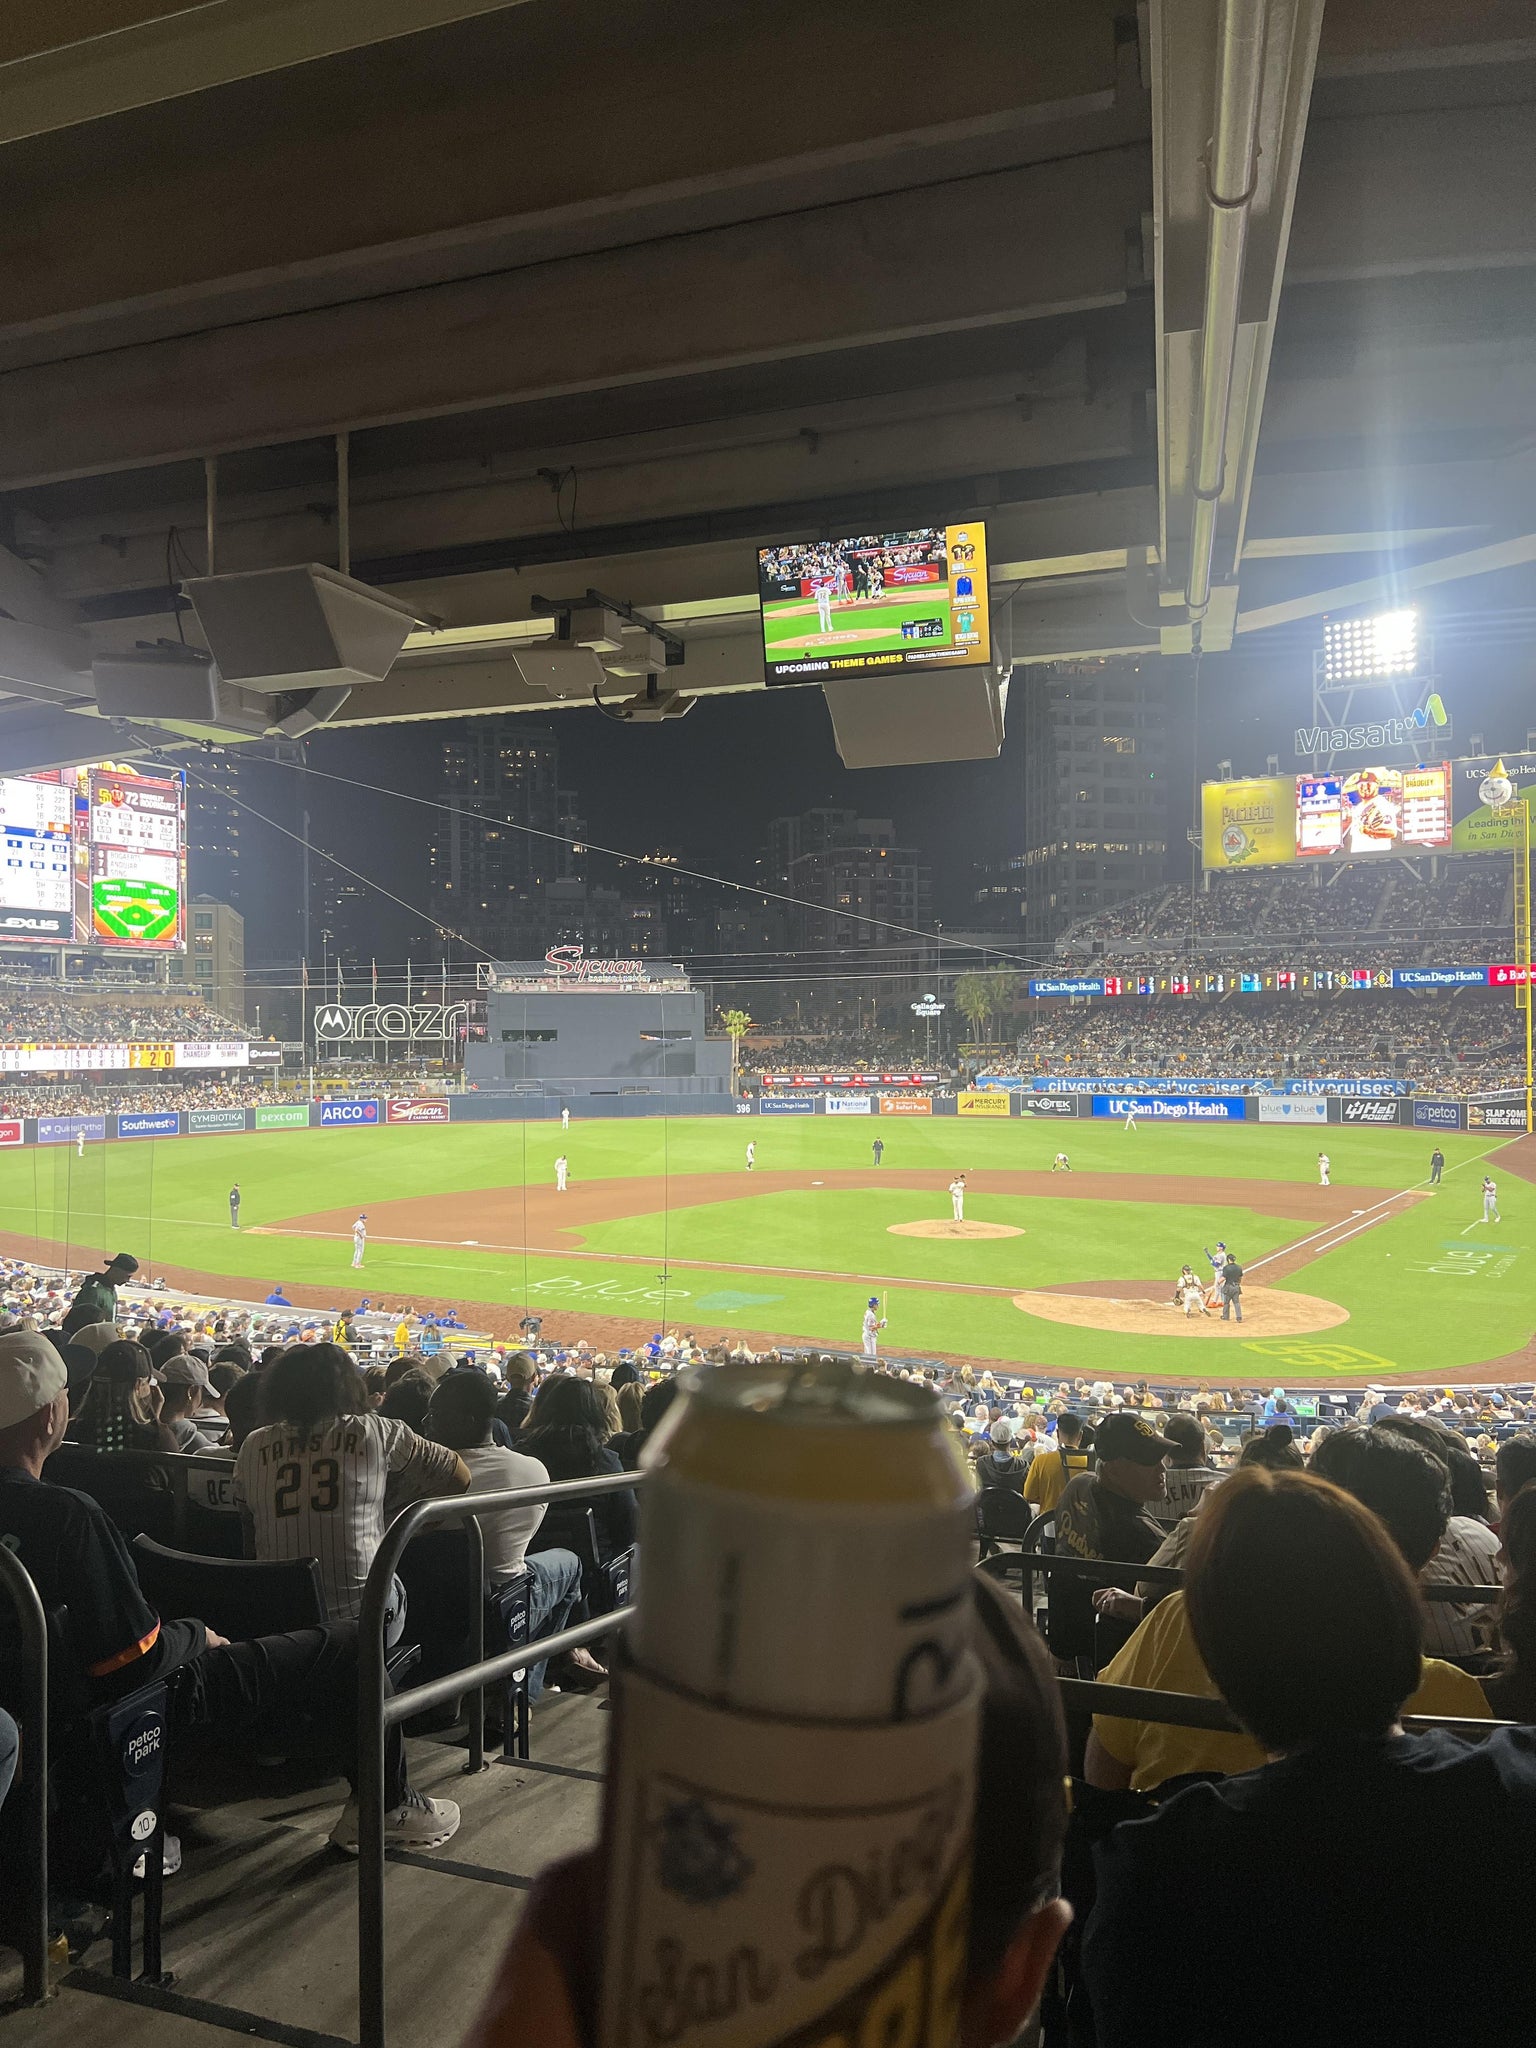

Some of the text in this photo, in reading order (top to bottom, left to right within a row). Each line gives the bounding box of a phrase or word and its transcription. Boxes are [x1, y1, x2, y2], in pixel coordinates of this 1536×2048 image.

[894, 568, 927, 582] Sycuan
[776, 654, 903, 674] UPCOMING THEME GAMES
[1298, 719, 1402, 754] Viasat
[1466, 770, 1479, 778] UC
[125, 791, 139, 806] 72
[1468, 817, 1508, 829] Leading
[1468, 832, 1476, 840] in
[1481, 832, 1496, 840] San
[544, 946, 646, 981] Sycuan
[1400, 972, 1413, 982] UC
[1415, 973, 1430, 981] San
[1431, 972, 1455, 982] Diego
[1456, 971, 1483, 980] Health
[1036, 983, 1046, 991] UC
[1047, 983, 1059, 991] San
[1060, 983, 1078, 992] Diego
[1079, 982, 1100, 990] Health
[911, 1003, 945, 1012] Gallagher
[916, 1009, 940, 1017] Square
[355, 1004, 467, 1040] razr
[150, 1052, 157, 1066] 2
[164, 1052, 171, 1066] 0
[1292, 1080, 1394, 1095] citycruises
[391, 1101, 443, 1120] Sycuan
[736, 1104, 751, 1113] 396
[1027, 1098, 1071, 1110] EVOTEK
[1109, 1100, 1228, 1117] UC San Diego Health
[1261, 1104, 1281, 1112] blue
[1294, 1104, 1315, 1112] blue
[191, 1113, 243, 1123] CYMBIOTIKA
[323, 1106, 362, 1119] ARCO
[1428, 1106, 1456, 1120] petco
[1486, 1109, 1505, 1117] SLAP
[121, 1119, 169, 1130] Southwest
[527, 1276, 691, 1300] blue
[511, 1287, 661, 1305] CALIFORNIA
[275, 1457, 340, 1519] 23
[617, 1578, 628, 1591] petco
[618, 1586, 628, 1597] park
[511, 1610, 526, 1627] petco
[513, 1618, 526, 1633] park
[128, 1726, 161, 1755] petco
[134, 1737, 160, 1764] park
[137, 1818, 150, 1834] 10
